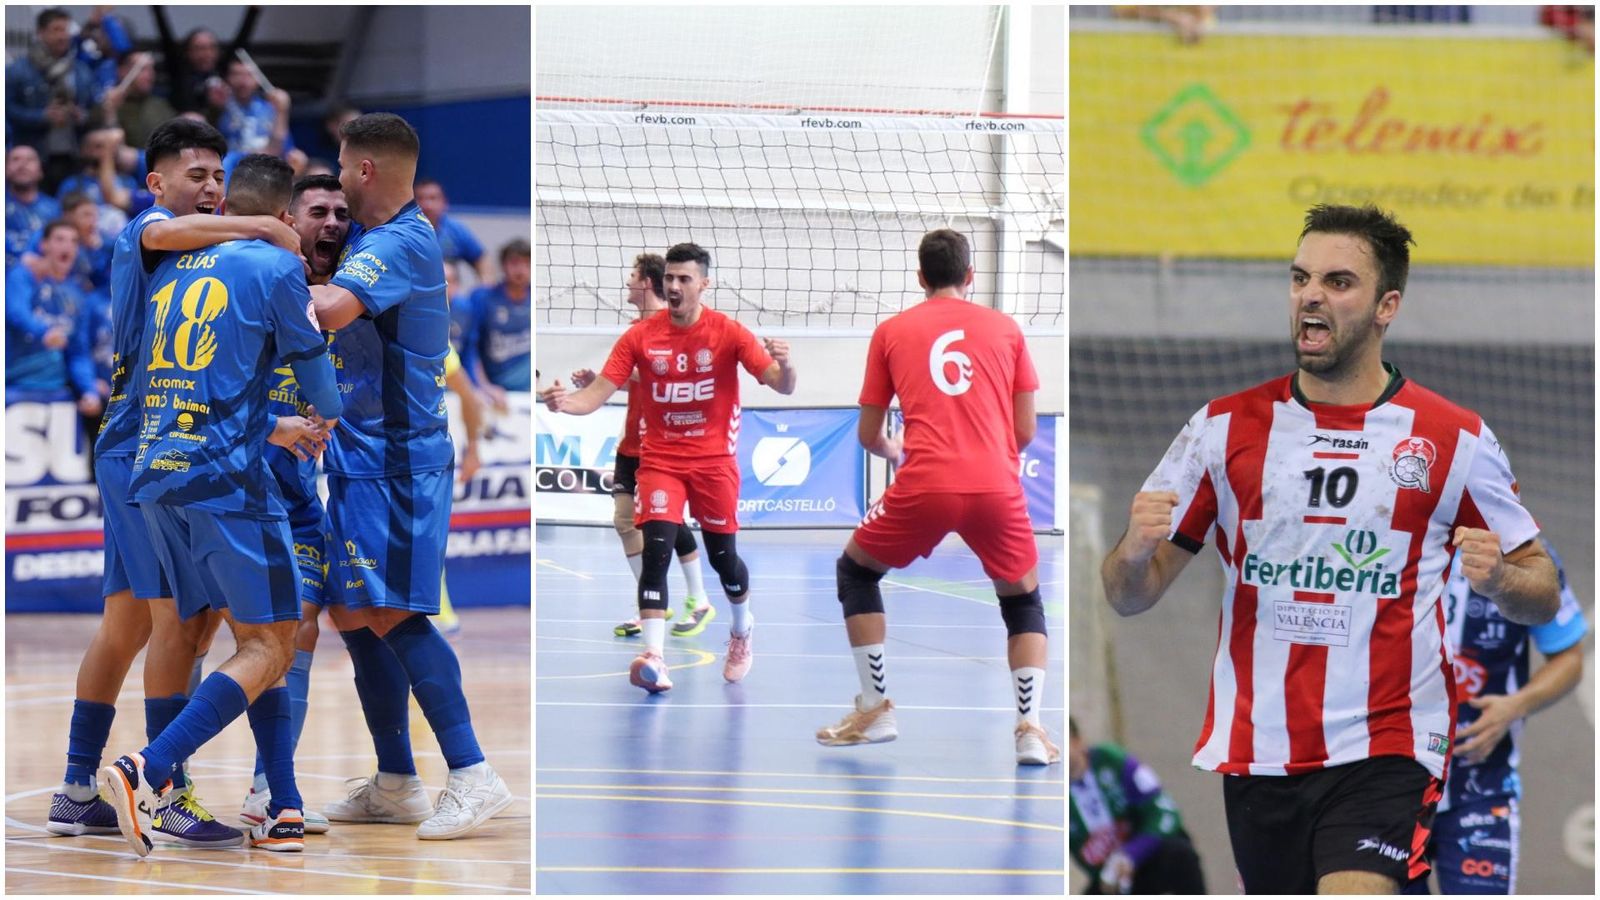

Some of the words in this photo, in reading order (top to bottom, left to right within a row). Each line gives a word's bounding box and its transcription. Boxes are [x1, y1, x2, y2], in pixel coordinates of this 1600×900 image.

[635, 114, 696, 126] rfevb.com
[801, 117, 862, 129] rfevb.com
[1277, 85, 1546, 156] telemix
[176, 252, 220, 270] ELÍAS
[147, 277, 229, 371] 18
[676, 353, 688, 373] 8
[929, 329, 974, 396] 6
[652, 378, 716, 403] UBE
[1303, 466, 1359, 508] 10
[1244, 553, 1398, 595] Fertiberia
